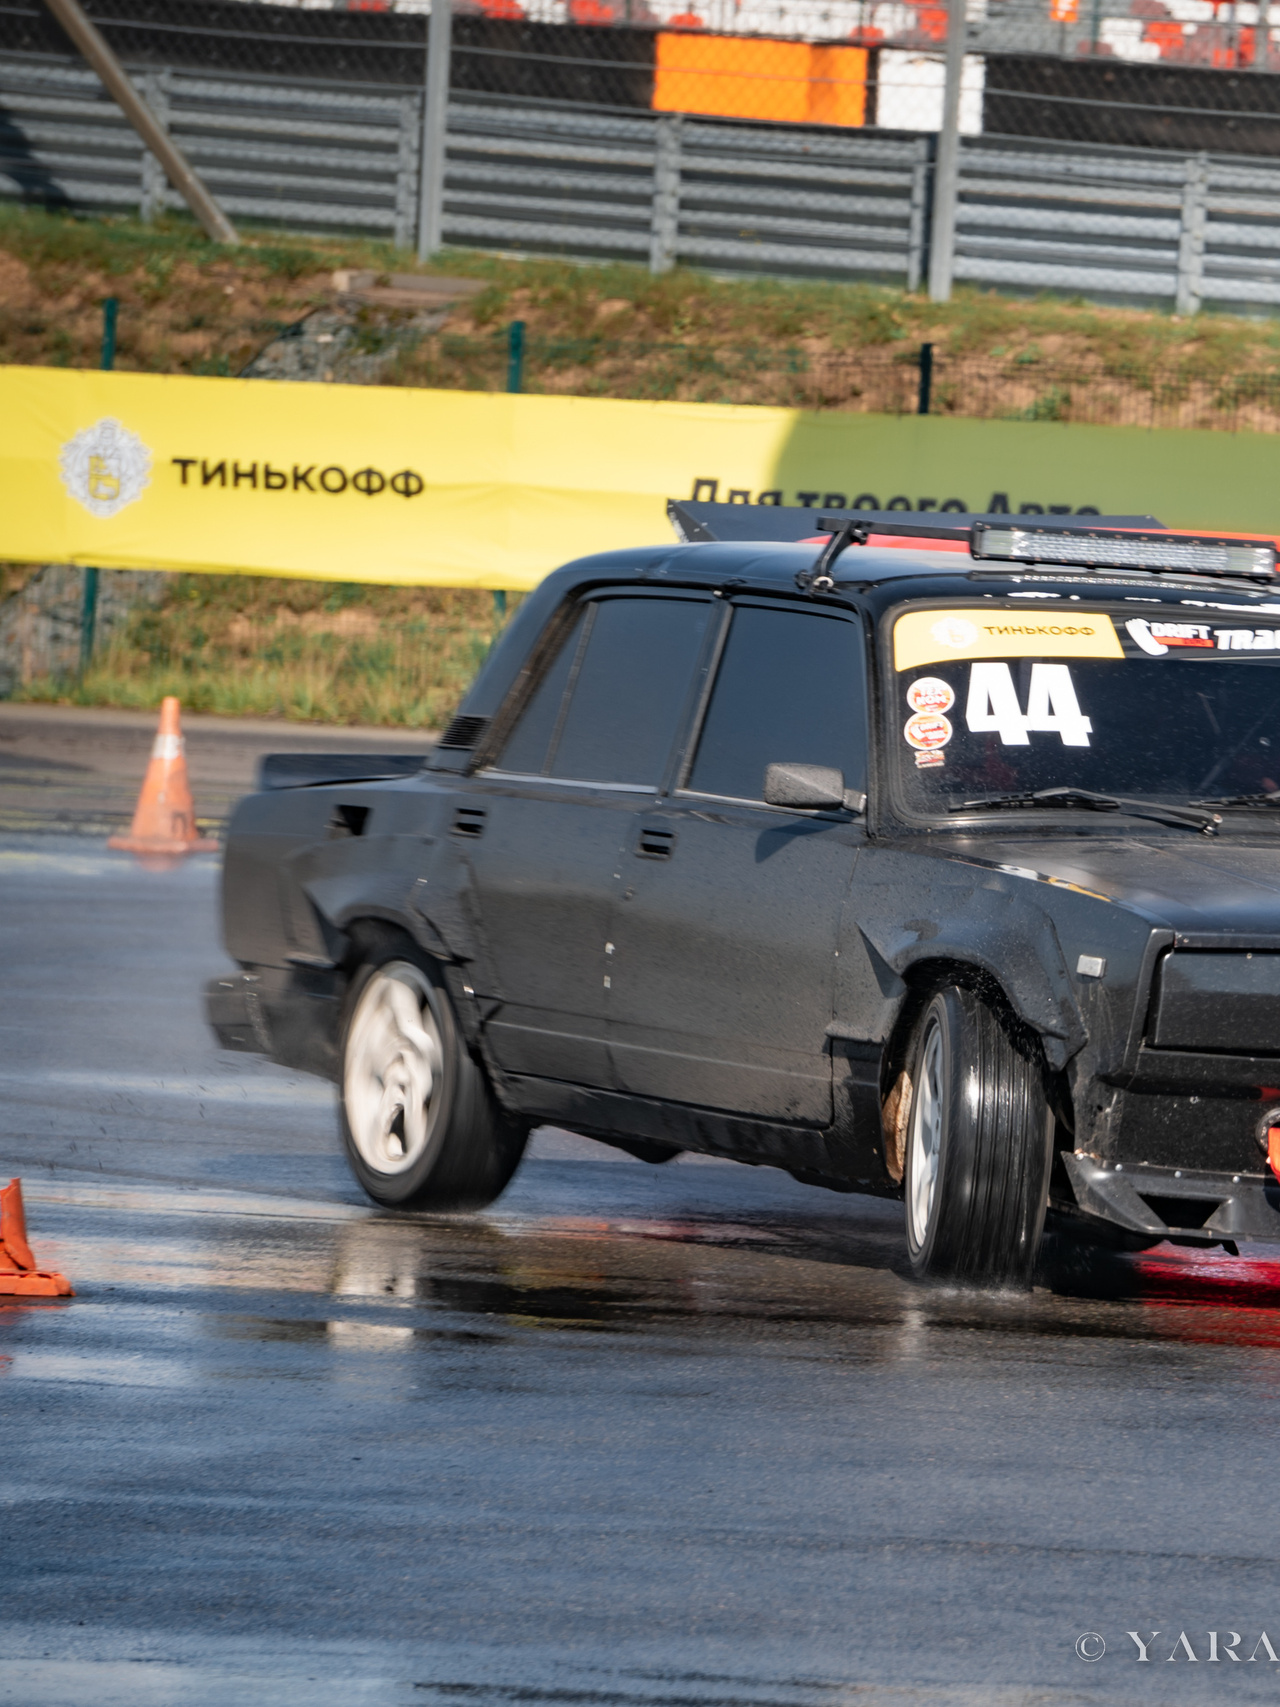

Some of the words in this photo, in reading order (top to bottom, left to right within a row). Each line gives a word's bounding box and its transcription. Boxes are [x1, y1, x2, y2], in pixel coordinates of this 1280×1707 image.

[171, 458, 424, 498] ТИНЬКОФФ
[984, 625, 1095, 636] ТИНЬКОФФ
[1150, 622, 1211, 640] DRIFT
[966, 662, 1093, 747] 44
